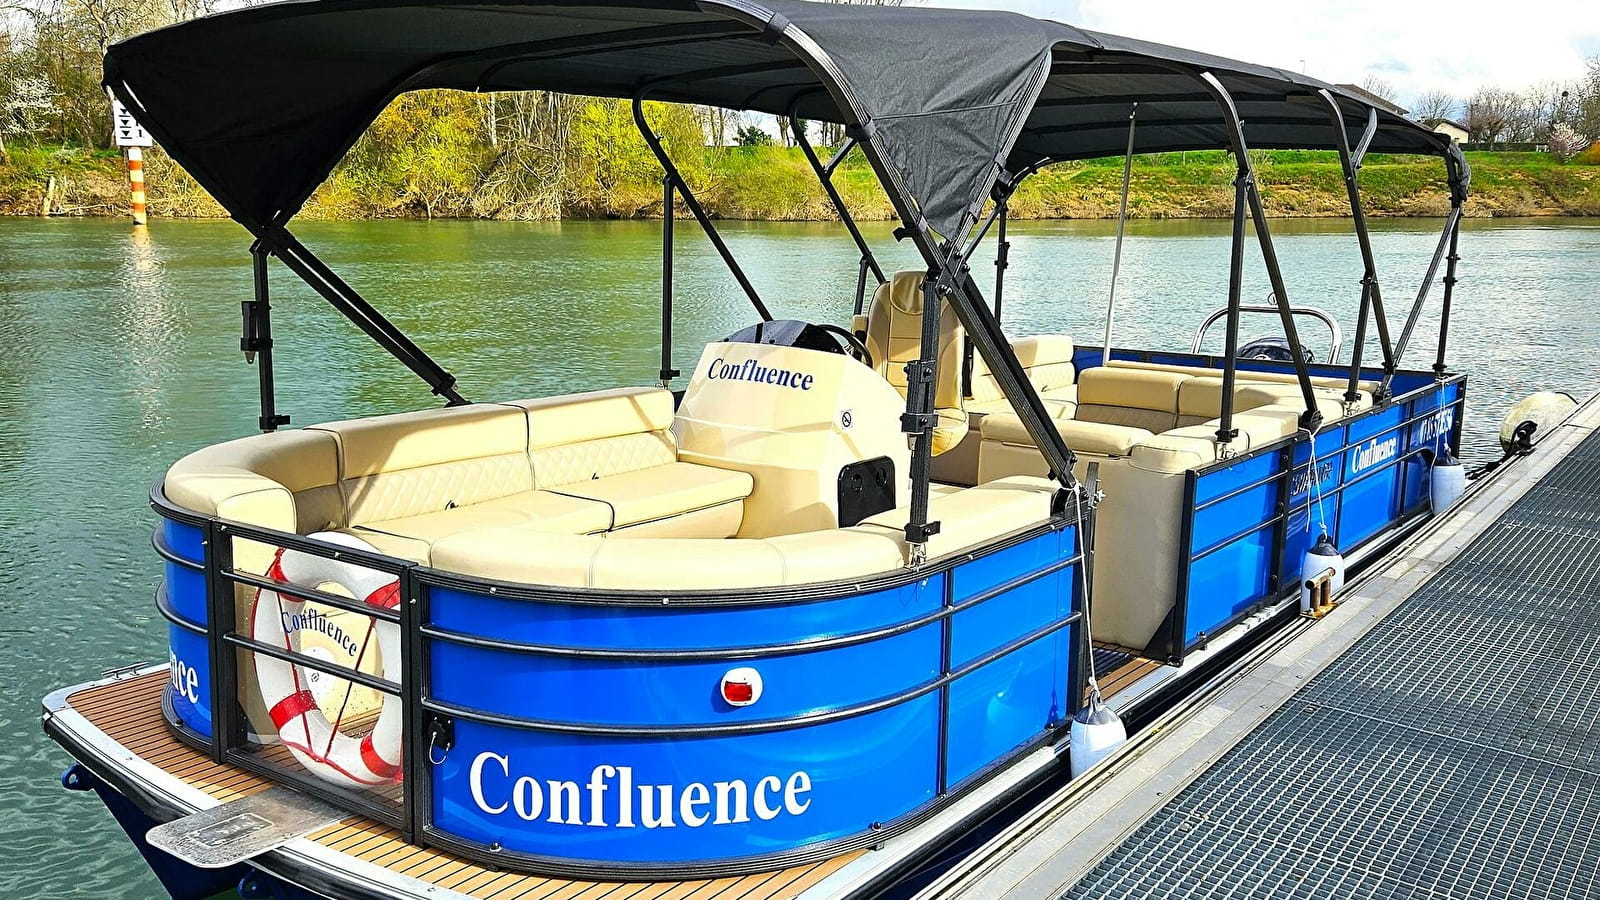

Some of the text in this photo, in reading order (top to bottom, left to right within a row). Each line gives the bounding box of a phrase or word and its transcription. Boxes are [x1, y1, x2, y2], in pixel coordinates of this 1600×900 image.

[707, 358, 814, 390] Confluence
[1351, 437, 1397, 474] Confluence
[281, 608, 358, 657] Confluence
[469, 751, 812, 829] Confluence
